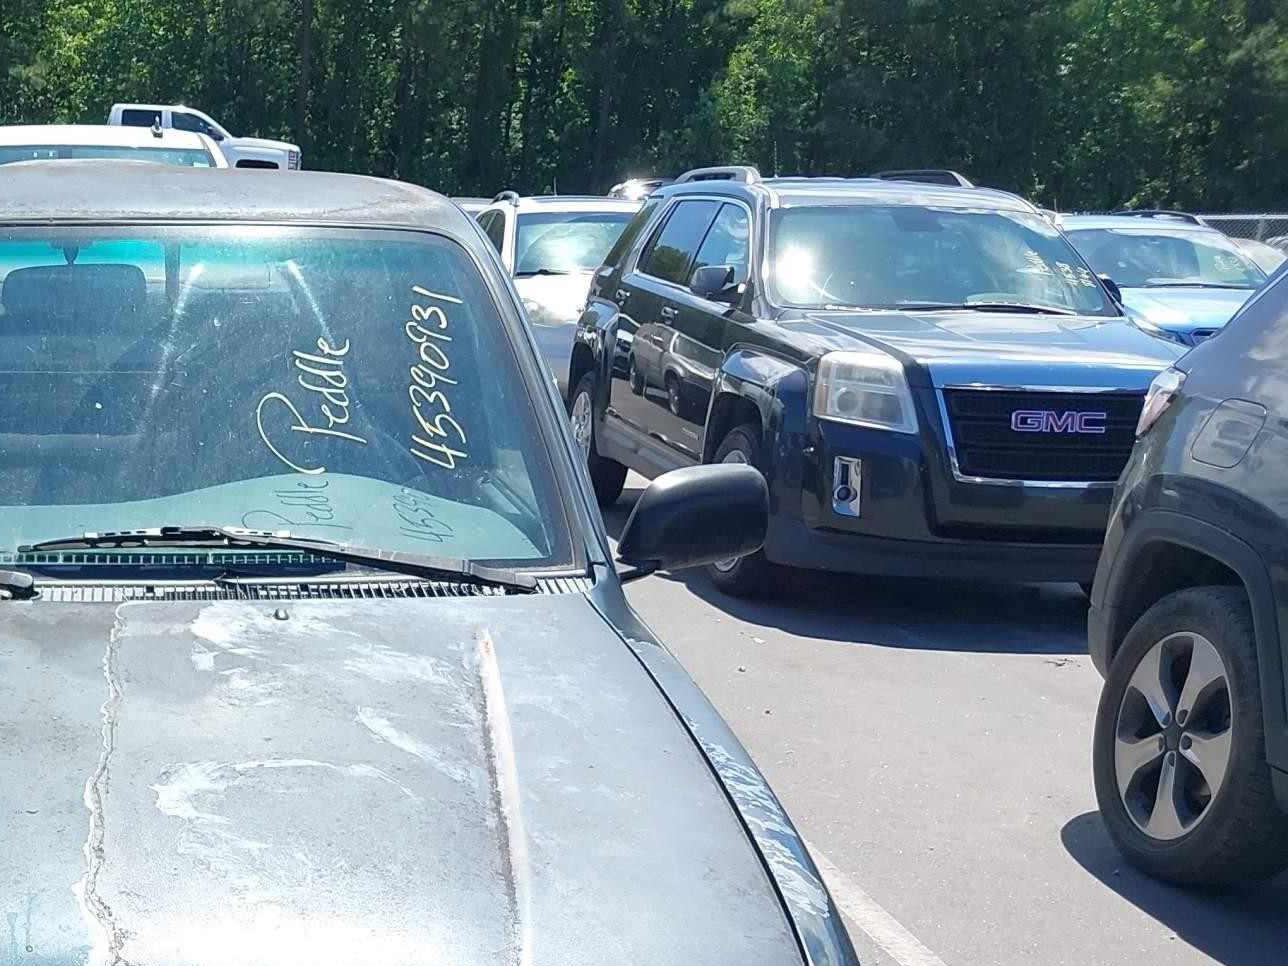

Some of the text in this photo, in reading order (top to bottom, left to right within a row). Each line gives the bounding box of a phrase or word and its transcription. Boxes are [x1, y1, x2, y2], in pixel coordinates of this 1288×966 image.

[256, 336, 368, 475] Peddle
[405, 285, 468, 470] 45390931
[1011, 410, 1107, 434] GMC
